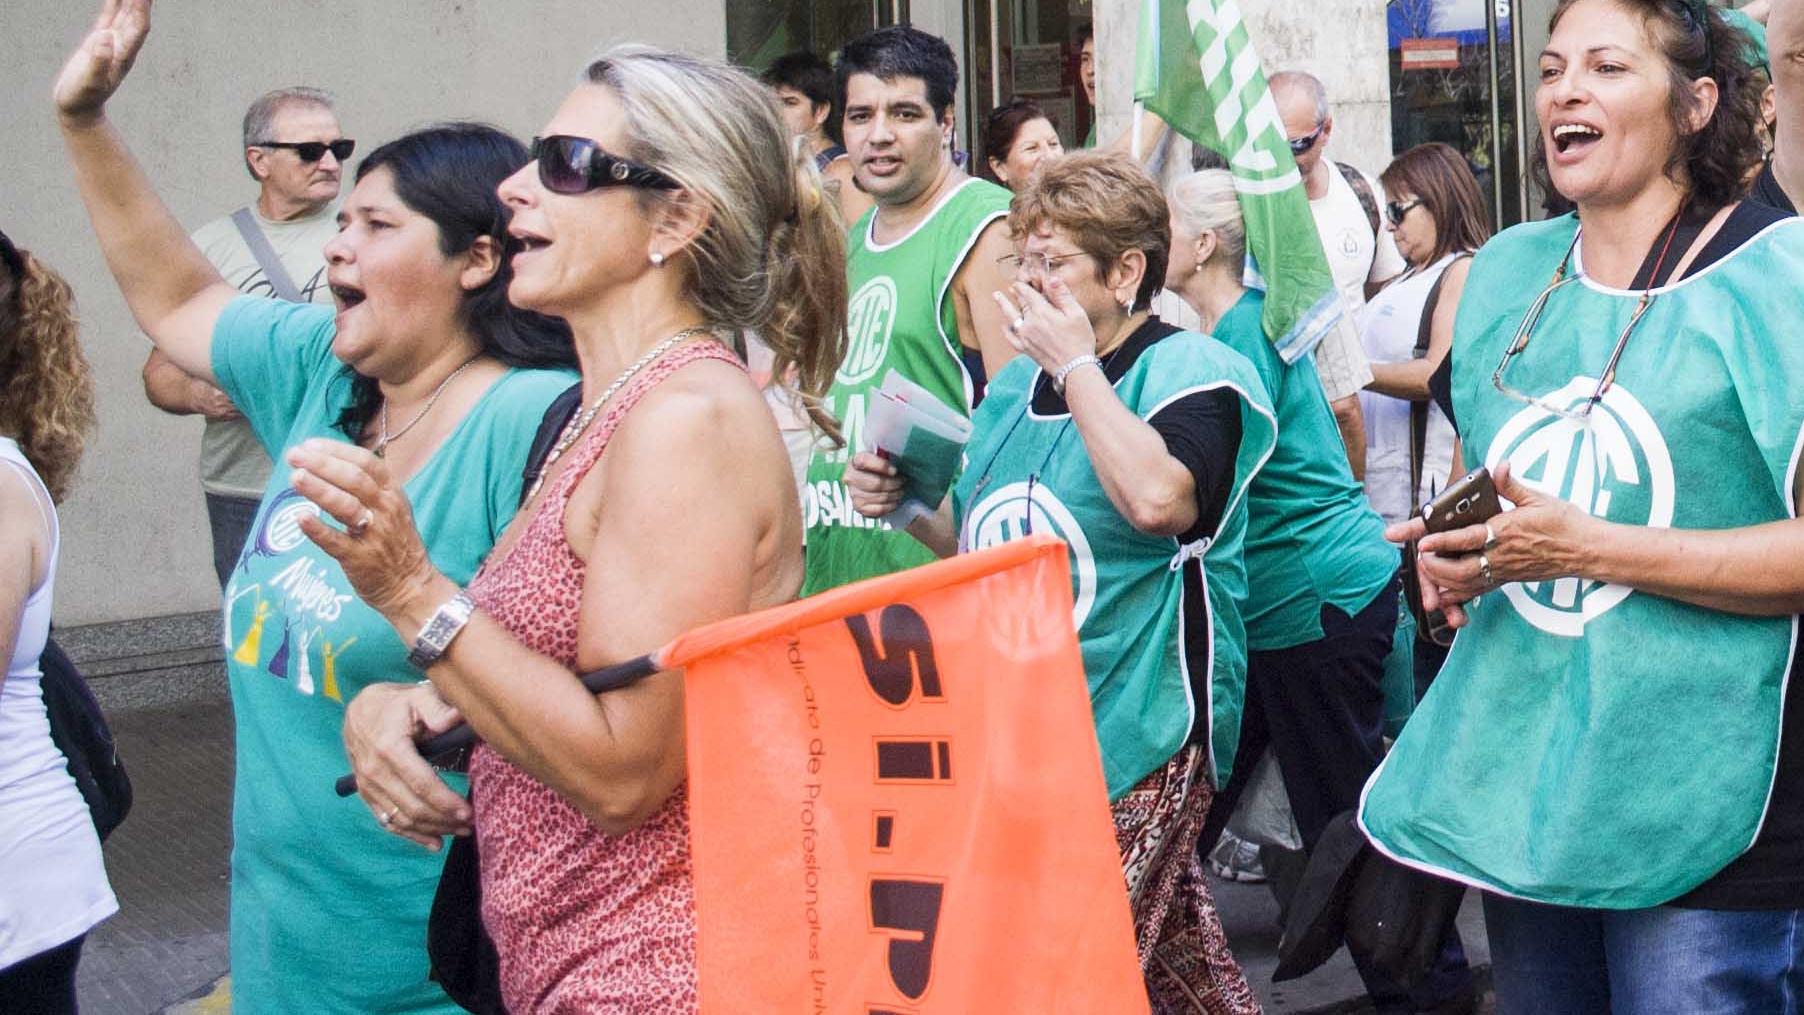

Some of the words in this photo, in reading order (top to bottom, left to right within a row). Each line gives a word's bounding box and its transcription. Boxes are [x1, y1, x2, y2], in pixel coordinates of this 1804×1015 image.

[807, 738, 827, 775] de
[845, 603, 951, 1015] Si.P
[800, 784, 823, 962] Profesionales
